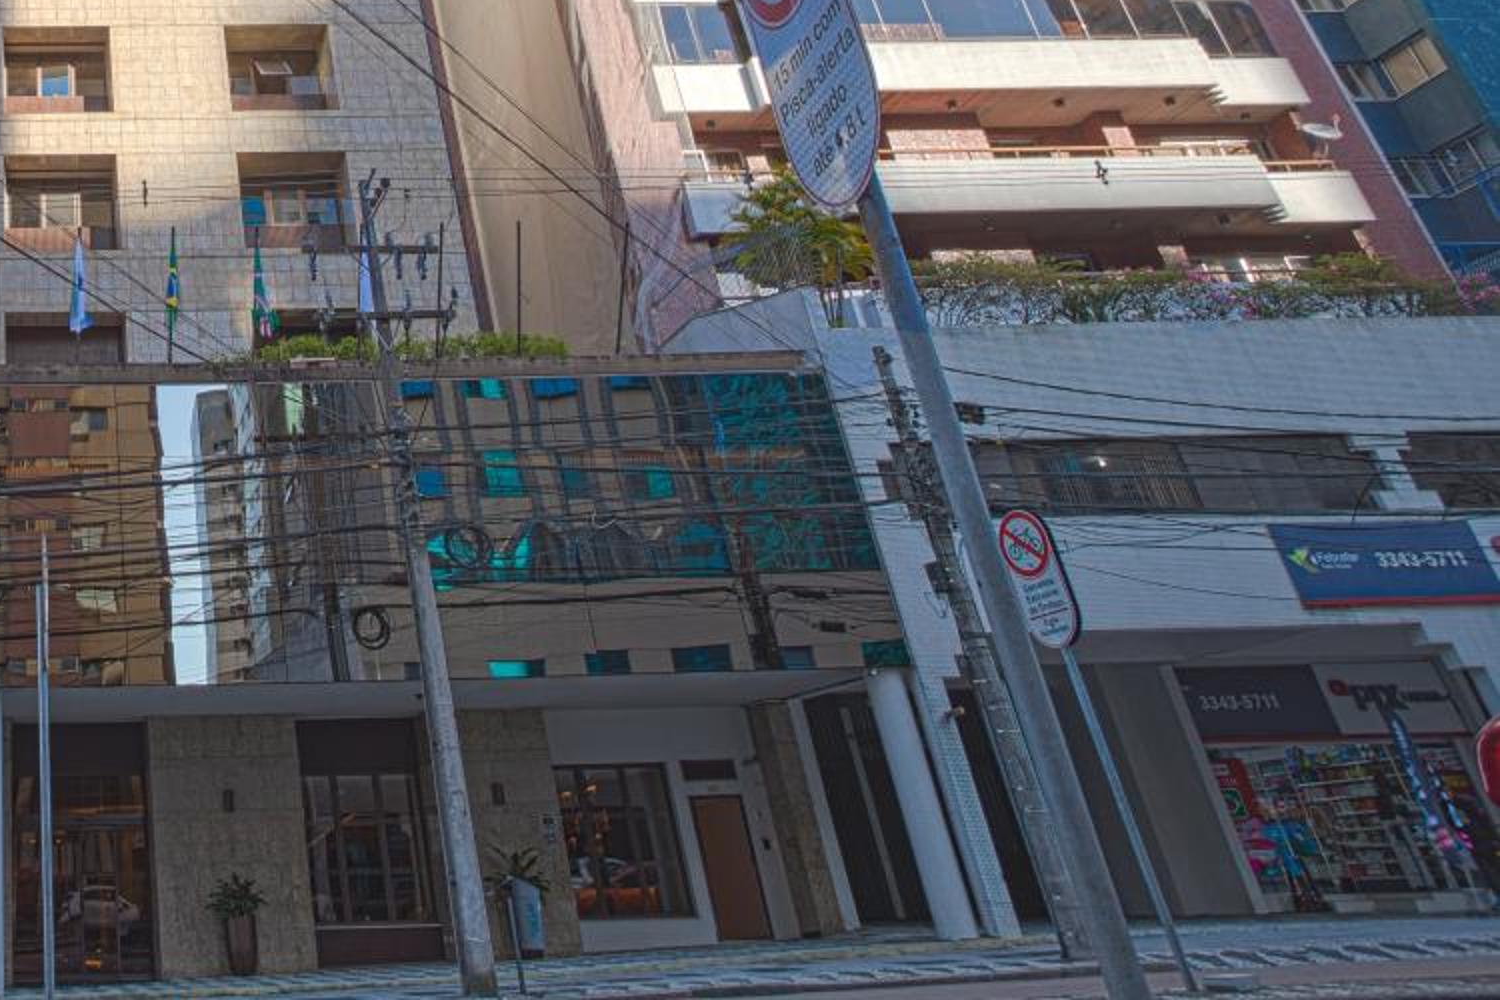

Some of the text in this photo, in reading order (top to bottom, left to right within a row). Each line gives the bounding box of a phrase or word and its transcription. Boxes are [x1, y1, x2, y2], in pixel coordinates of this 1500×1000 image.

[772, 66, 790, 92] 15
[788, 37, 814, 74] min
[778, 24, 857, 127] Pisca-alerta
[804, 83, 849, 140] ligado
[1374, 550, 1469, 568] 3343-5711
[1200, 692, 1282, 712] 3343-5711
